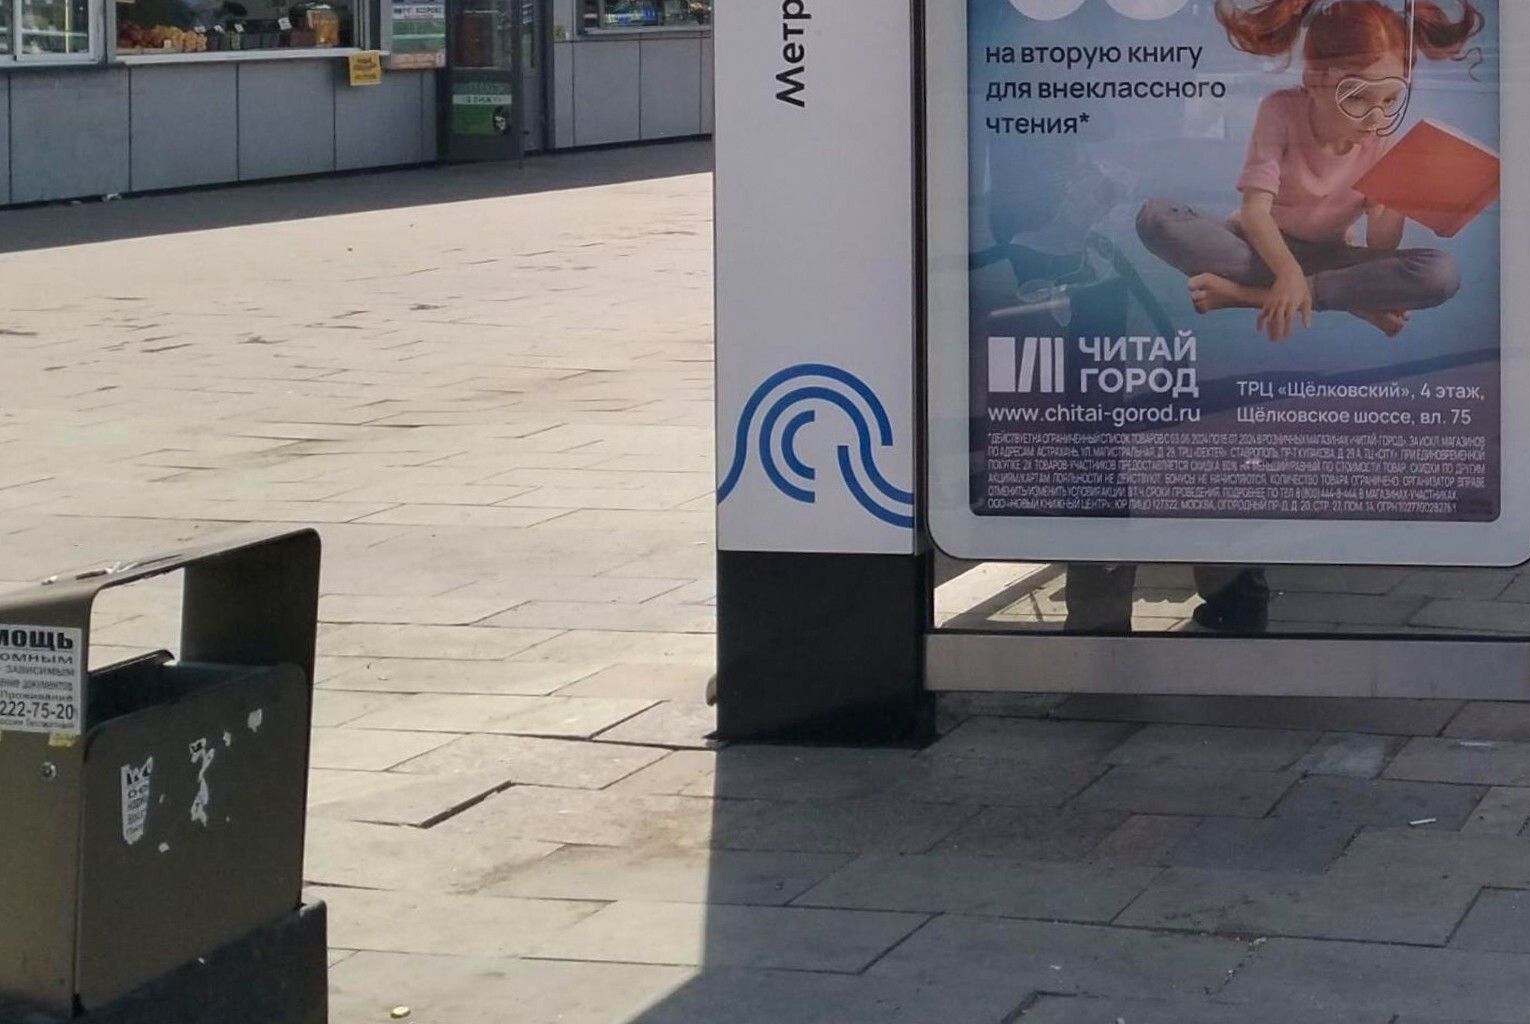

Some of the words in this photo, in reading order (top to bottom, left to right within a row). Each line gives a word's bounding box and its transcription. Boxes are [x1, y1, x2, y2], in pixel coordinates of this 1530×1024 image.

[985, 46, 1016, 64] на
[1020, 45, 1121, 70] вторую
[1127, 45, 1204, 70] книгу
[985, 81, 1033, 102] для
[1037, 80, 1227, 100] внеклассного
[1078, 330, 1198, 362] ЧИТАЙ
[1079, 368, 1200, 398] ГОРОД
[1236, 380, 1274, 400] ТРЦ
[1278, 379, 1416, 403] «Щёлковский»,
[1420, 381, 1431, 398] 4
[1435, 384, 1486, 403] этаж,
[988, 404, 1201, 428] www.chitai-gorod.ru
[1236, 406, 1350, 428] Щёлковское
[1353, 410, 1415, 429] шоссе,
[1419, 410, 1445, 425] вл.
[1450, 409, 1472, 426] 75
